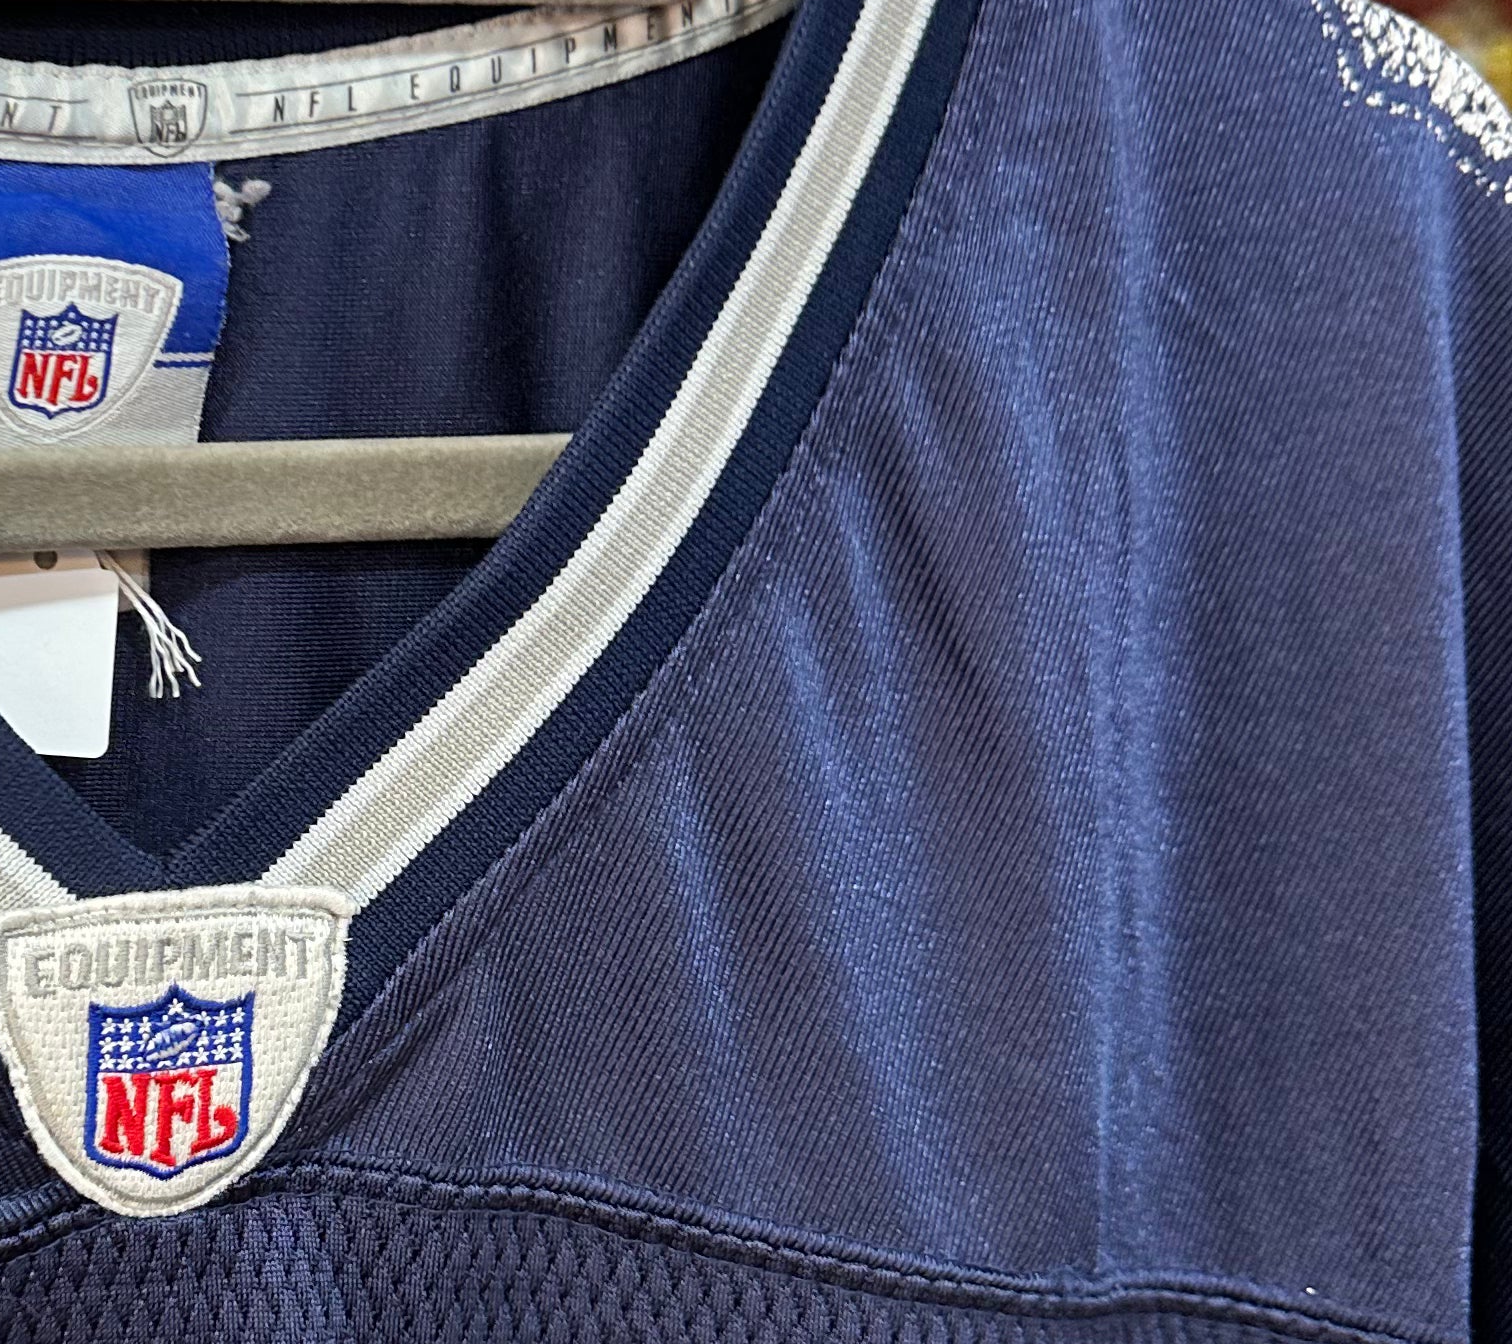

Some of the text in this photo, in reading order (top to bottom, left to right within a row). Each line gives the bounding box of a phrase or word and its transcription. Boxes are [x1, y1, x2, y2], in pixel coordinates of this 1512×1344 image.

[272, 85, 359, 124] NFL
[149, 120, 187, 144] NFL
[15, 352, 100, 406] NFL
[22, 924, 316, 999] EQUIPMENT
[98, 1067, 240, 1168] NFL
